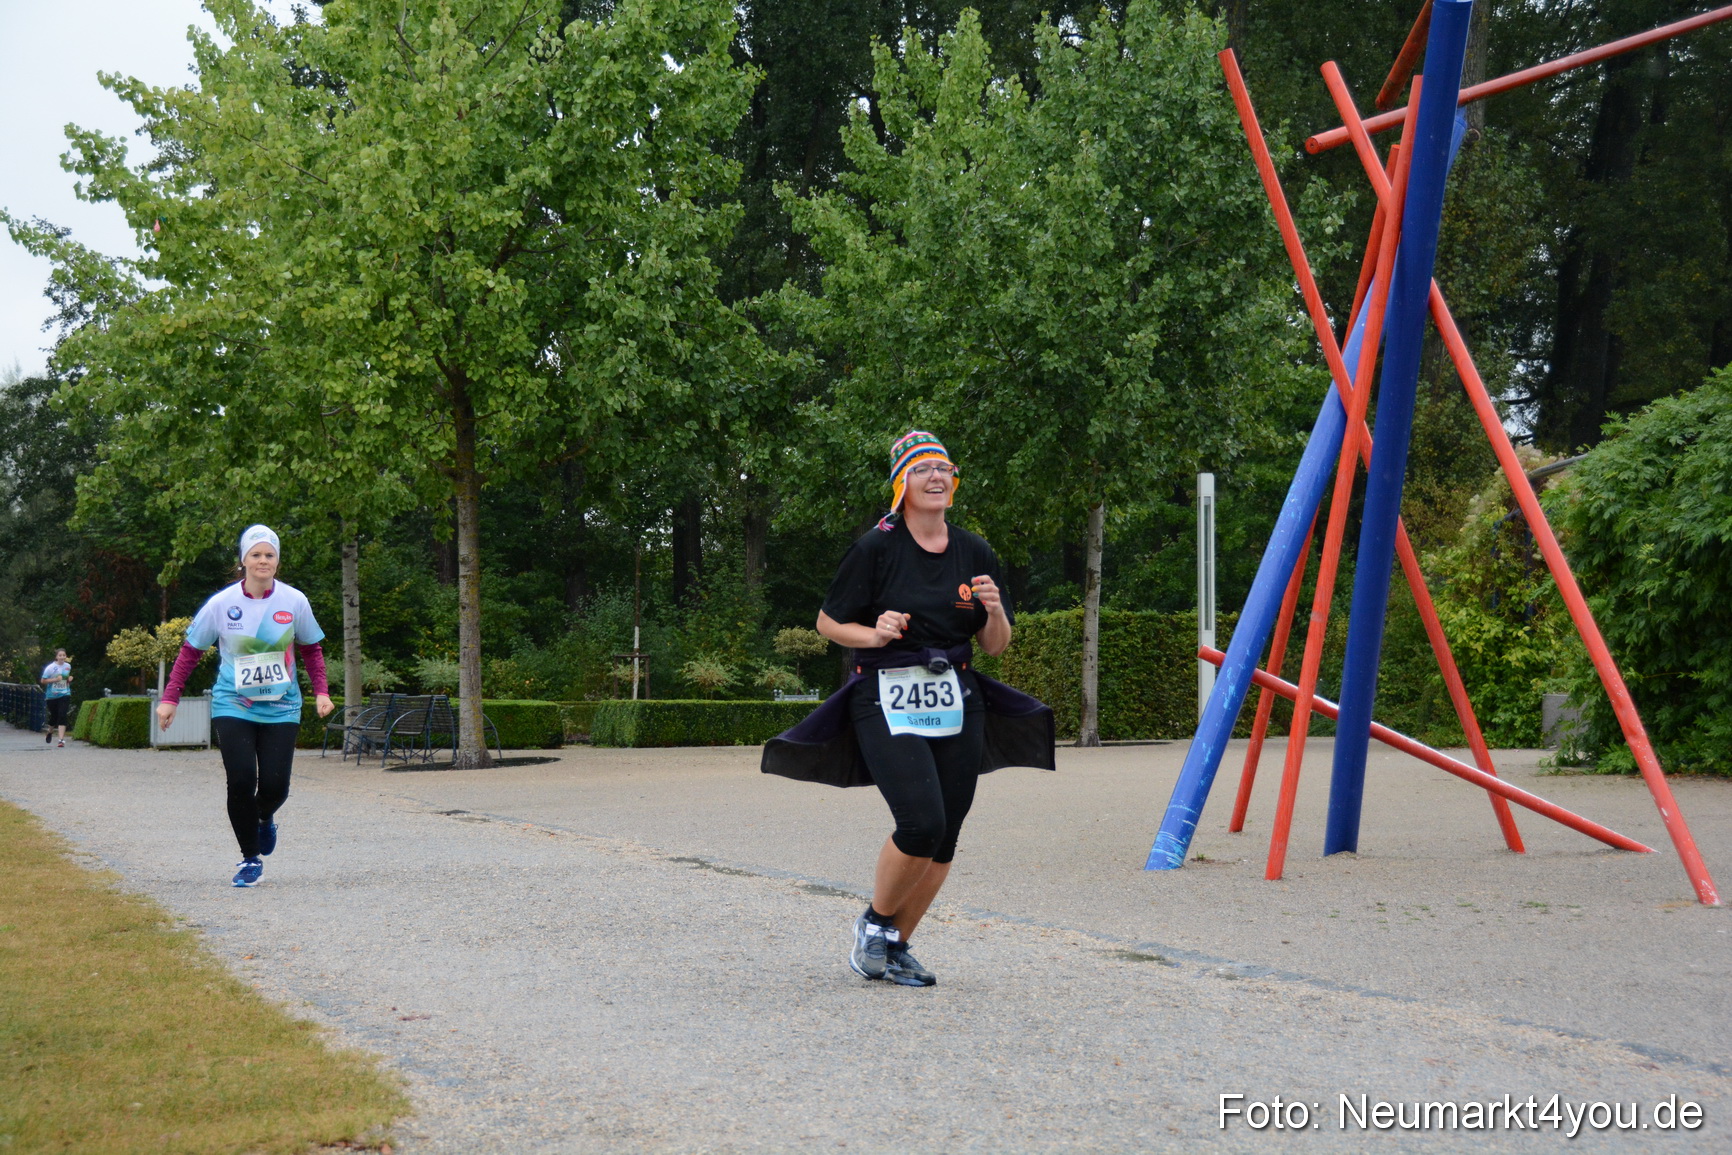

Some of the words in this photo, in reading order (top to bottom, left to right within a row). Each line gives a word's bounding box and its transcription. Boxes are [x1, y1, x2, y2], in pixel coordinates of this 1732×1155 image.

[241, 663, 284, 686] 2449
[259, 687, 272, 695] Iris
[889, 681, 955, 710] 2453
[907, 715, 941, 726] Sandra
